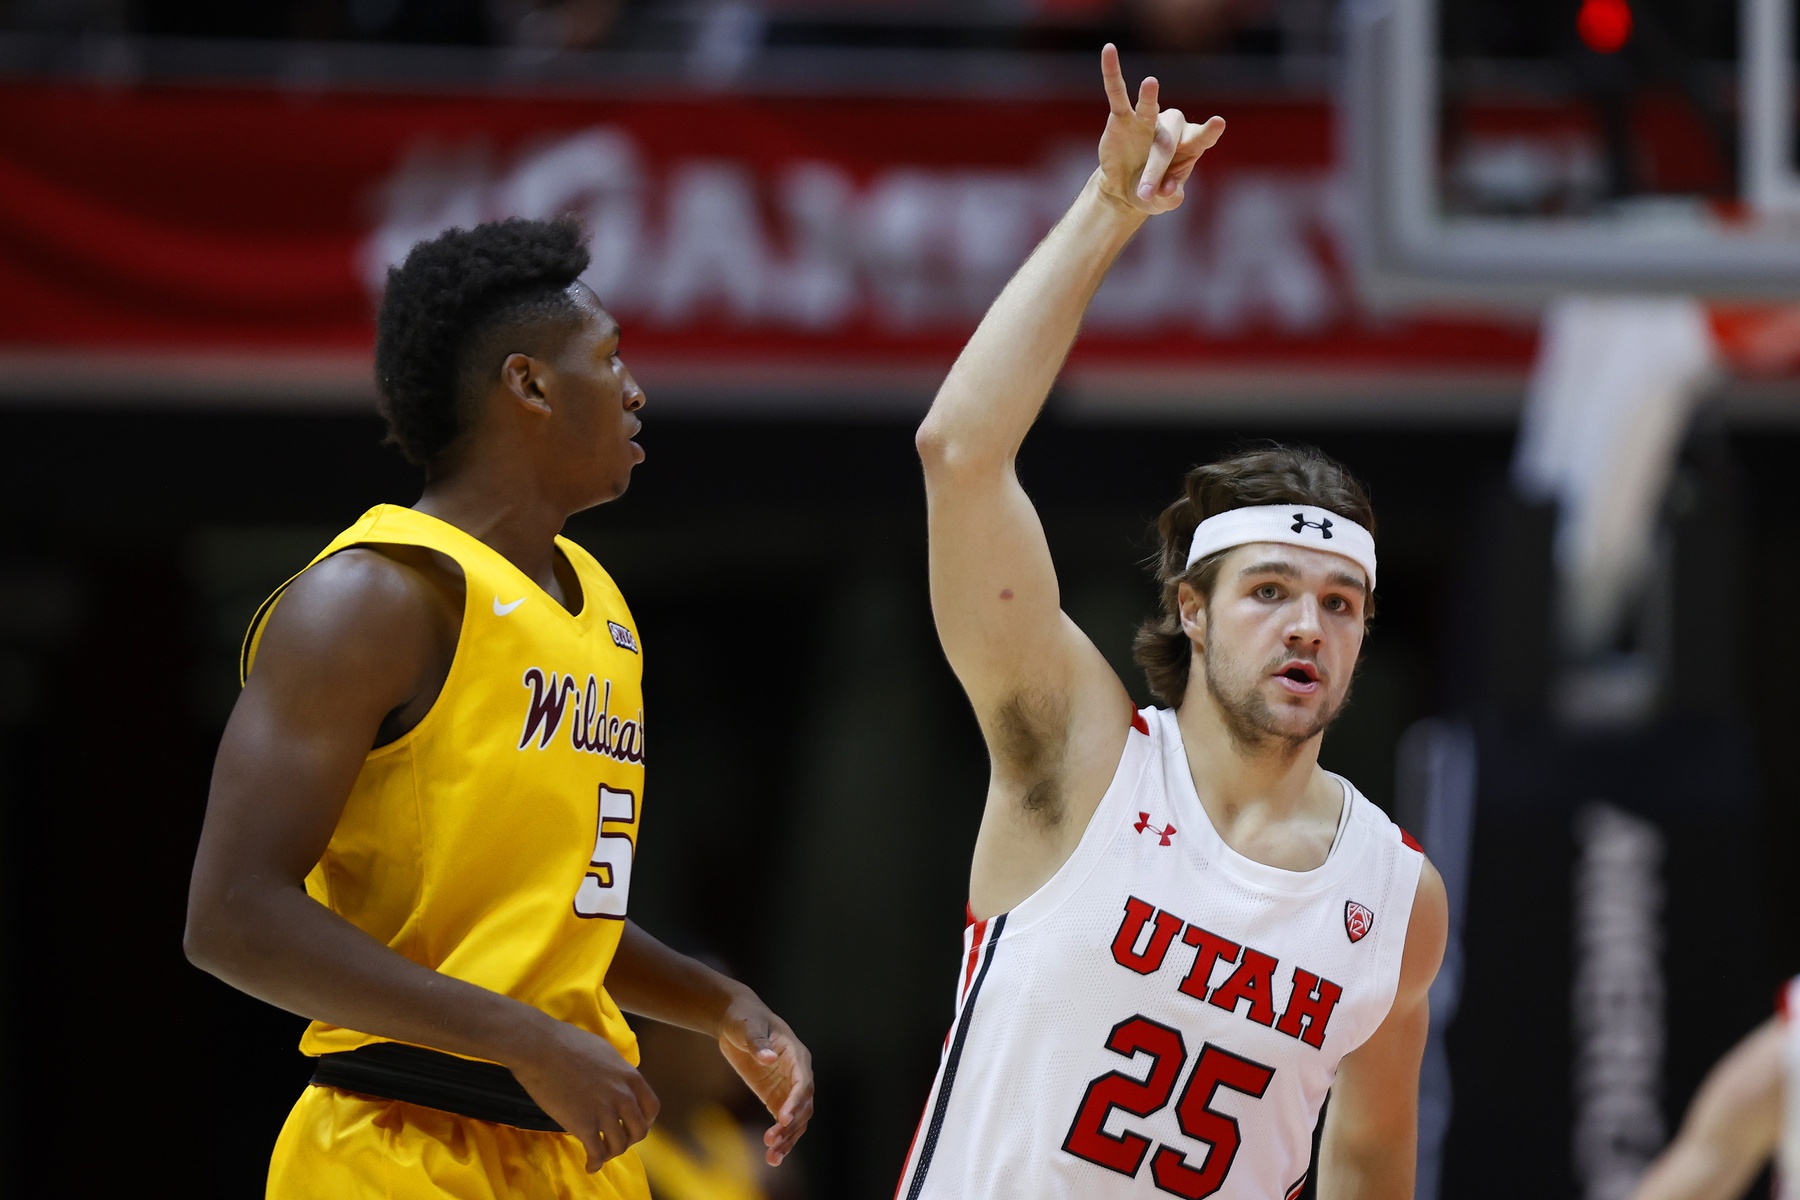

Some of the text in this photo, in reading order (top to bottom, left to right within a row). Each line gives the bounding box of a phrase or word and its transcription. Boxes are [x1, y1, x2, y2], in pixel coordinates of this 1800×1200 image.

[573, 782, 635, 920] 5
[1111, 895, 1343, 1050] UTAH
[1350, 918, 1364, 936] 12
[1061, 1013, 1277, 1200] 25
